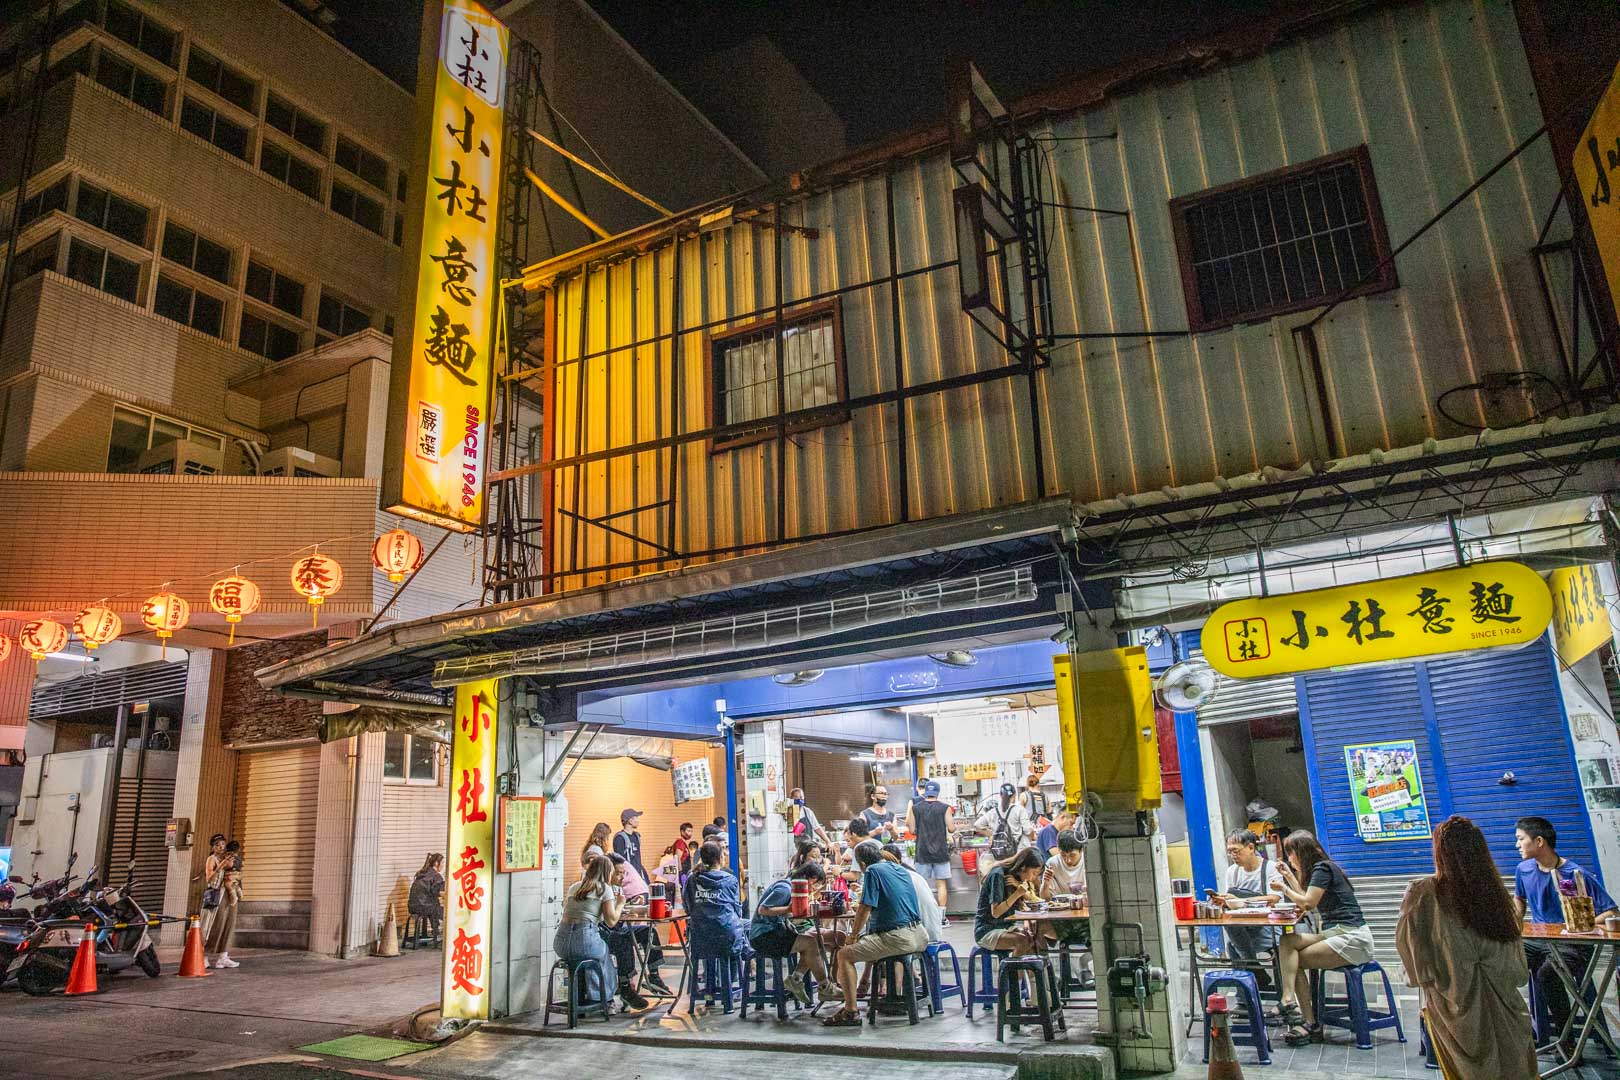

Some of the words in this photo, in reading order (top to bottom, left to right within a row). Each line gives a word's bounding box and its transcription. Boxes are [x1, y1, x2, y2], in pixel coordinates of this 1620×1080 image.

[456, 26, 489, 94] 小杜
[424, 106, 491, 387] 小杜意麵
[463, 404, 480, 460] SINCE
[461, 464, 478, 507] 1946
[212, 581, 244, 609] 福
[1279, 581, 1522, 651] 小杜意麵
[1236, 619, 1261, 661] 小杜
[1470, 629, 1497, 640] SINCE
[1499, 626, 1523, 636] 1946
[451, 694, 490, 996] 小杜意麵
